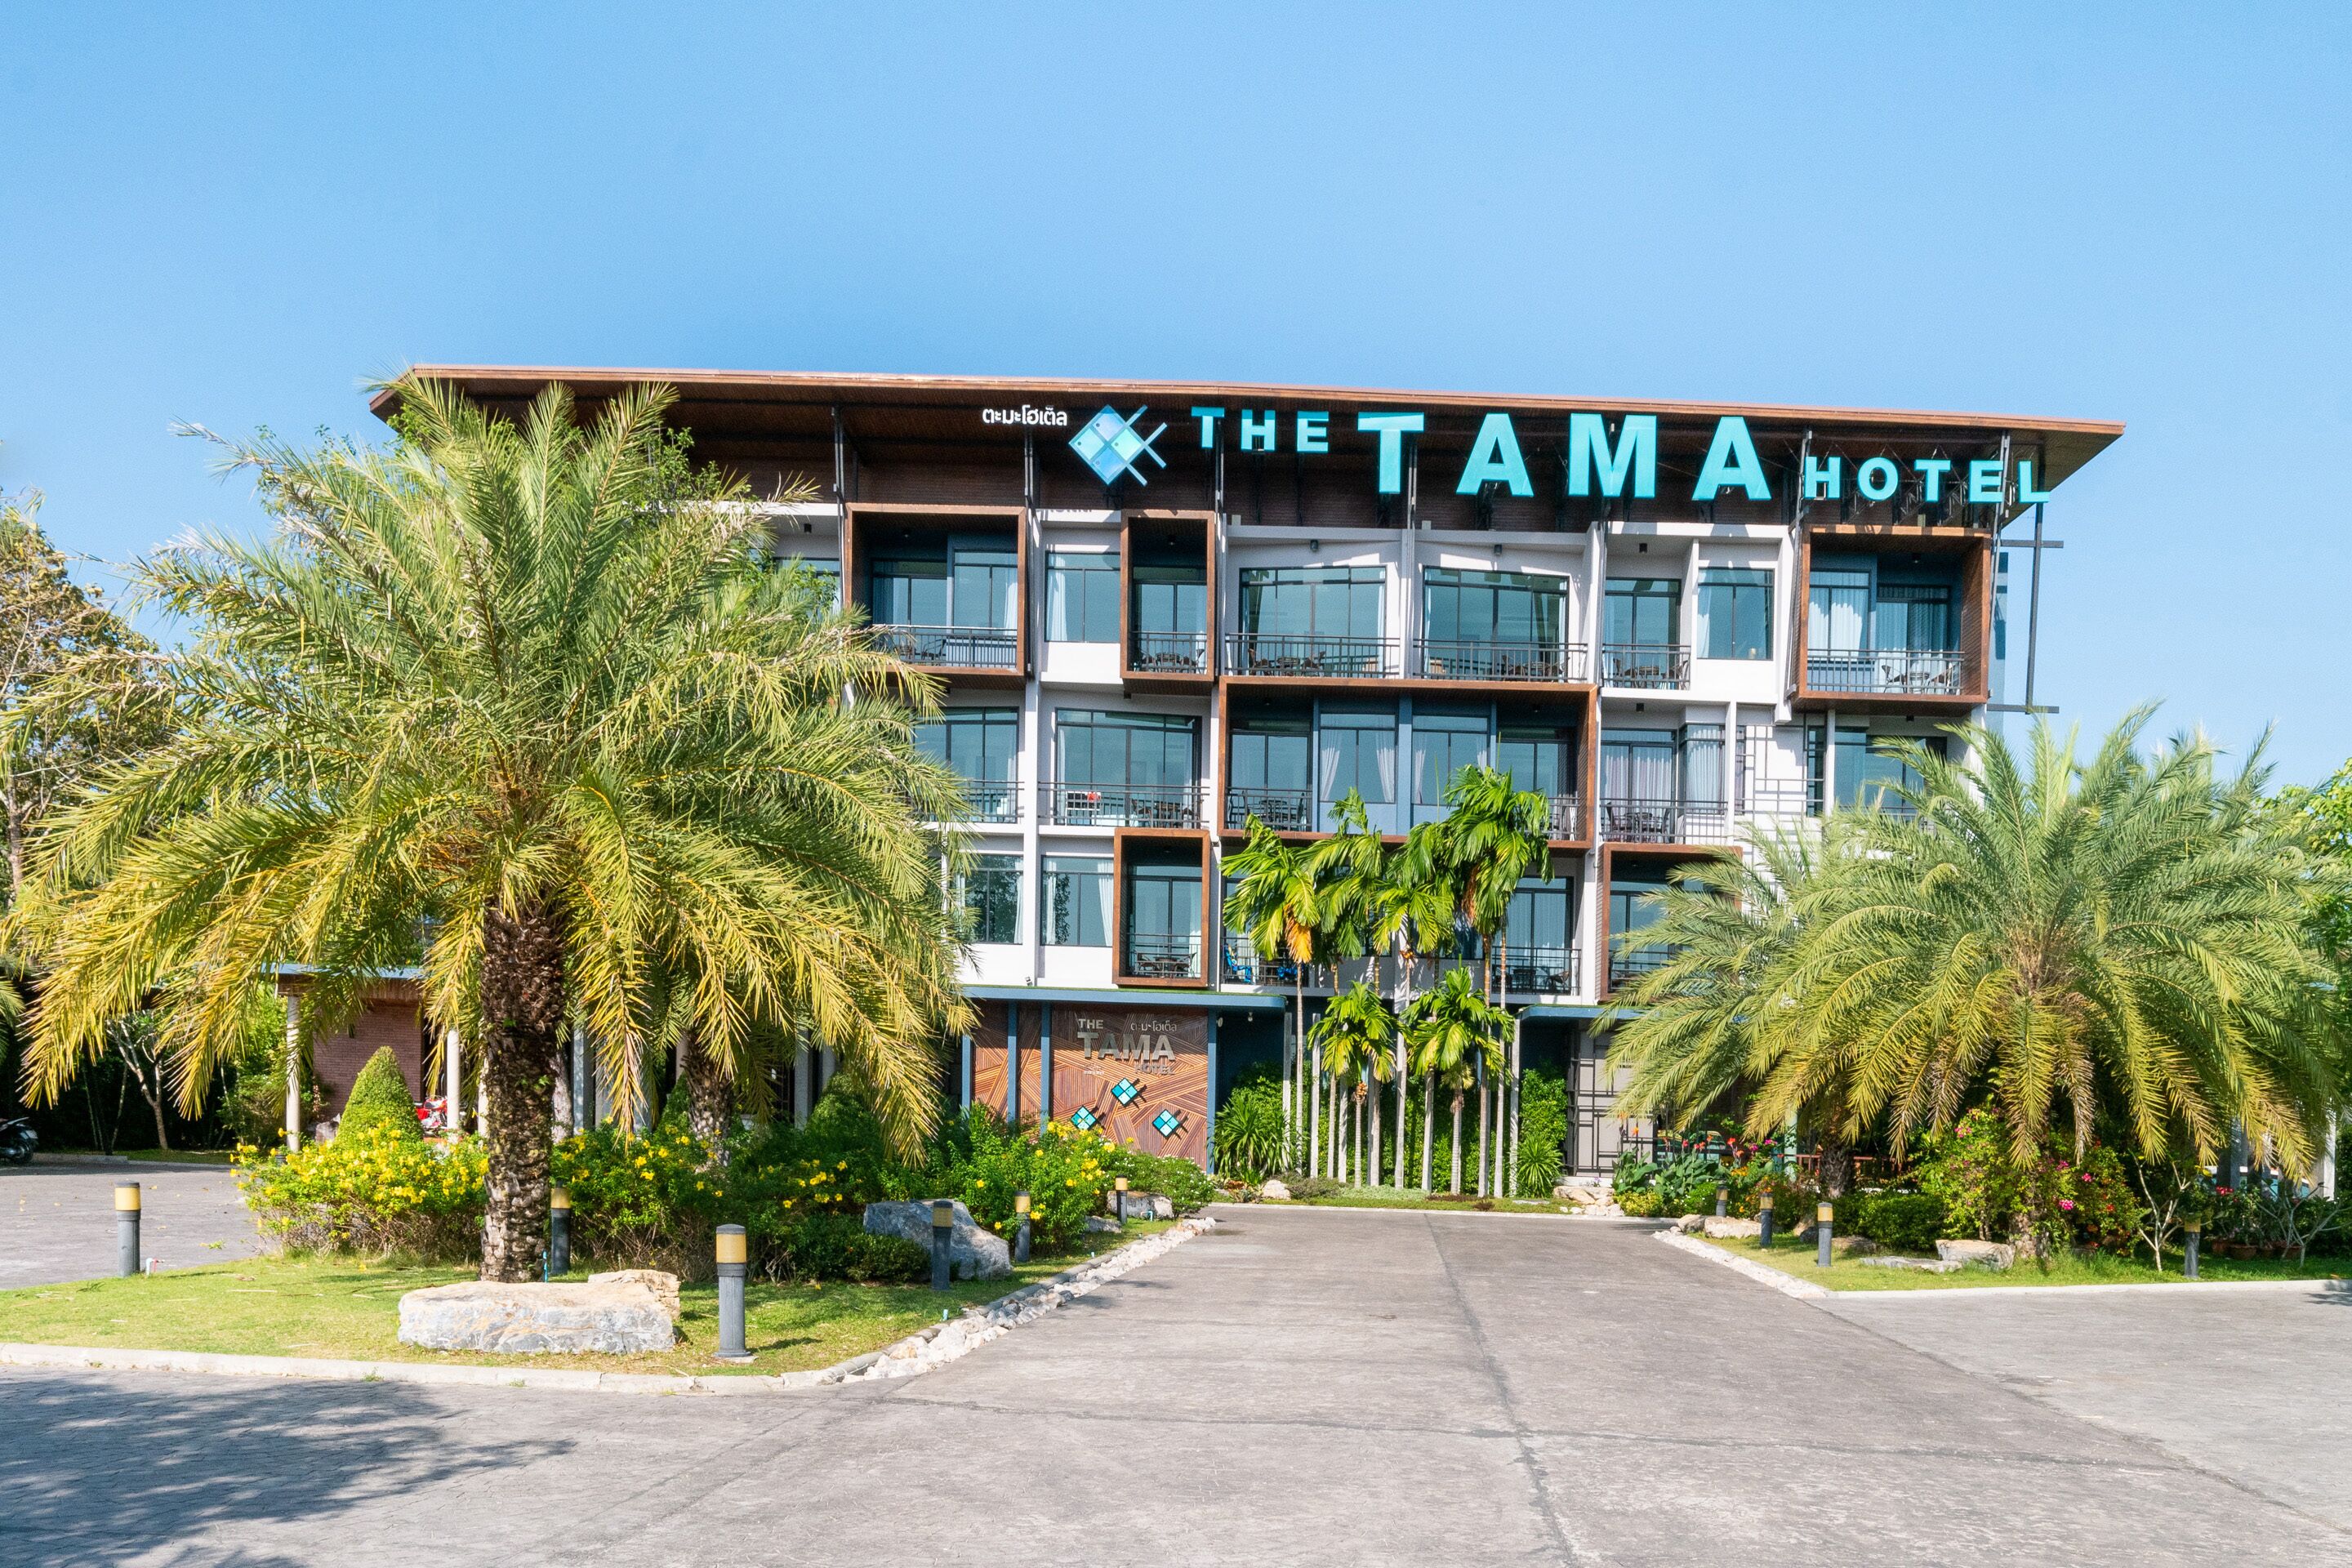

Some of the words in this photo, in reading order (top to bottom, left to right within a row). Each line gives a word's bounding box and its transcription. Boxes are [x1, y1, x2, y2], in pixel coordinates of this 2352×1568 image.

[1191, 407, 1329, 452] THE
[1357, 412, 1771, 501] TAMA
[1804, 456, 2050, 504] HOTEL
[1078, 1019, 1103, 1029] THE
[1077, 1032, 1176, 1061] TAMA
